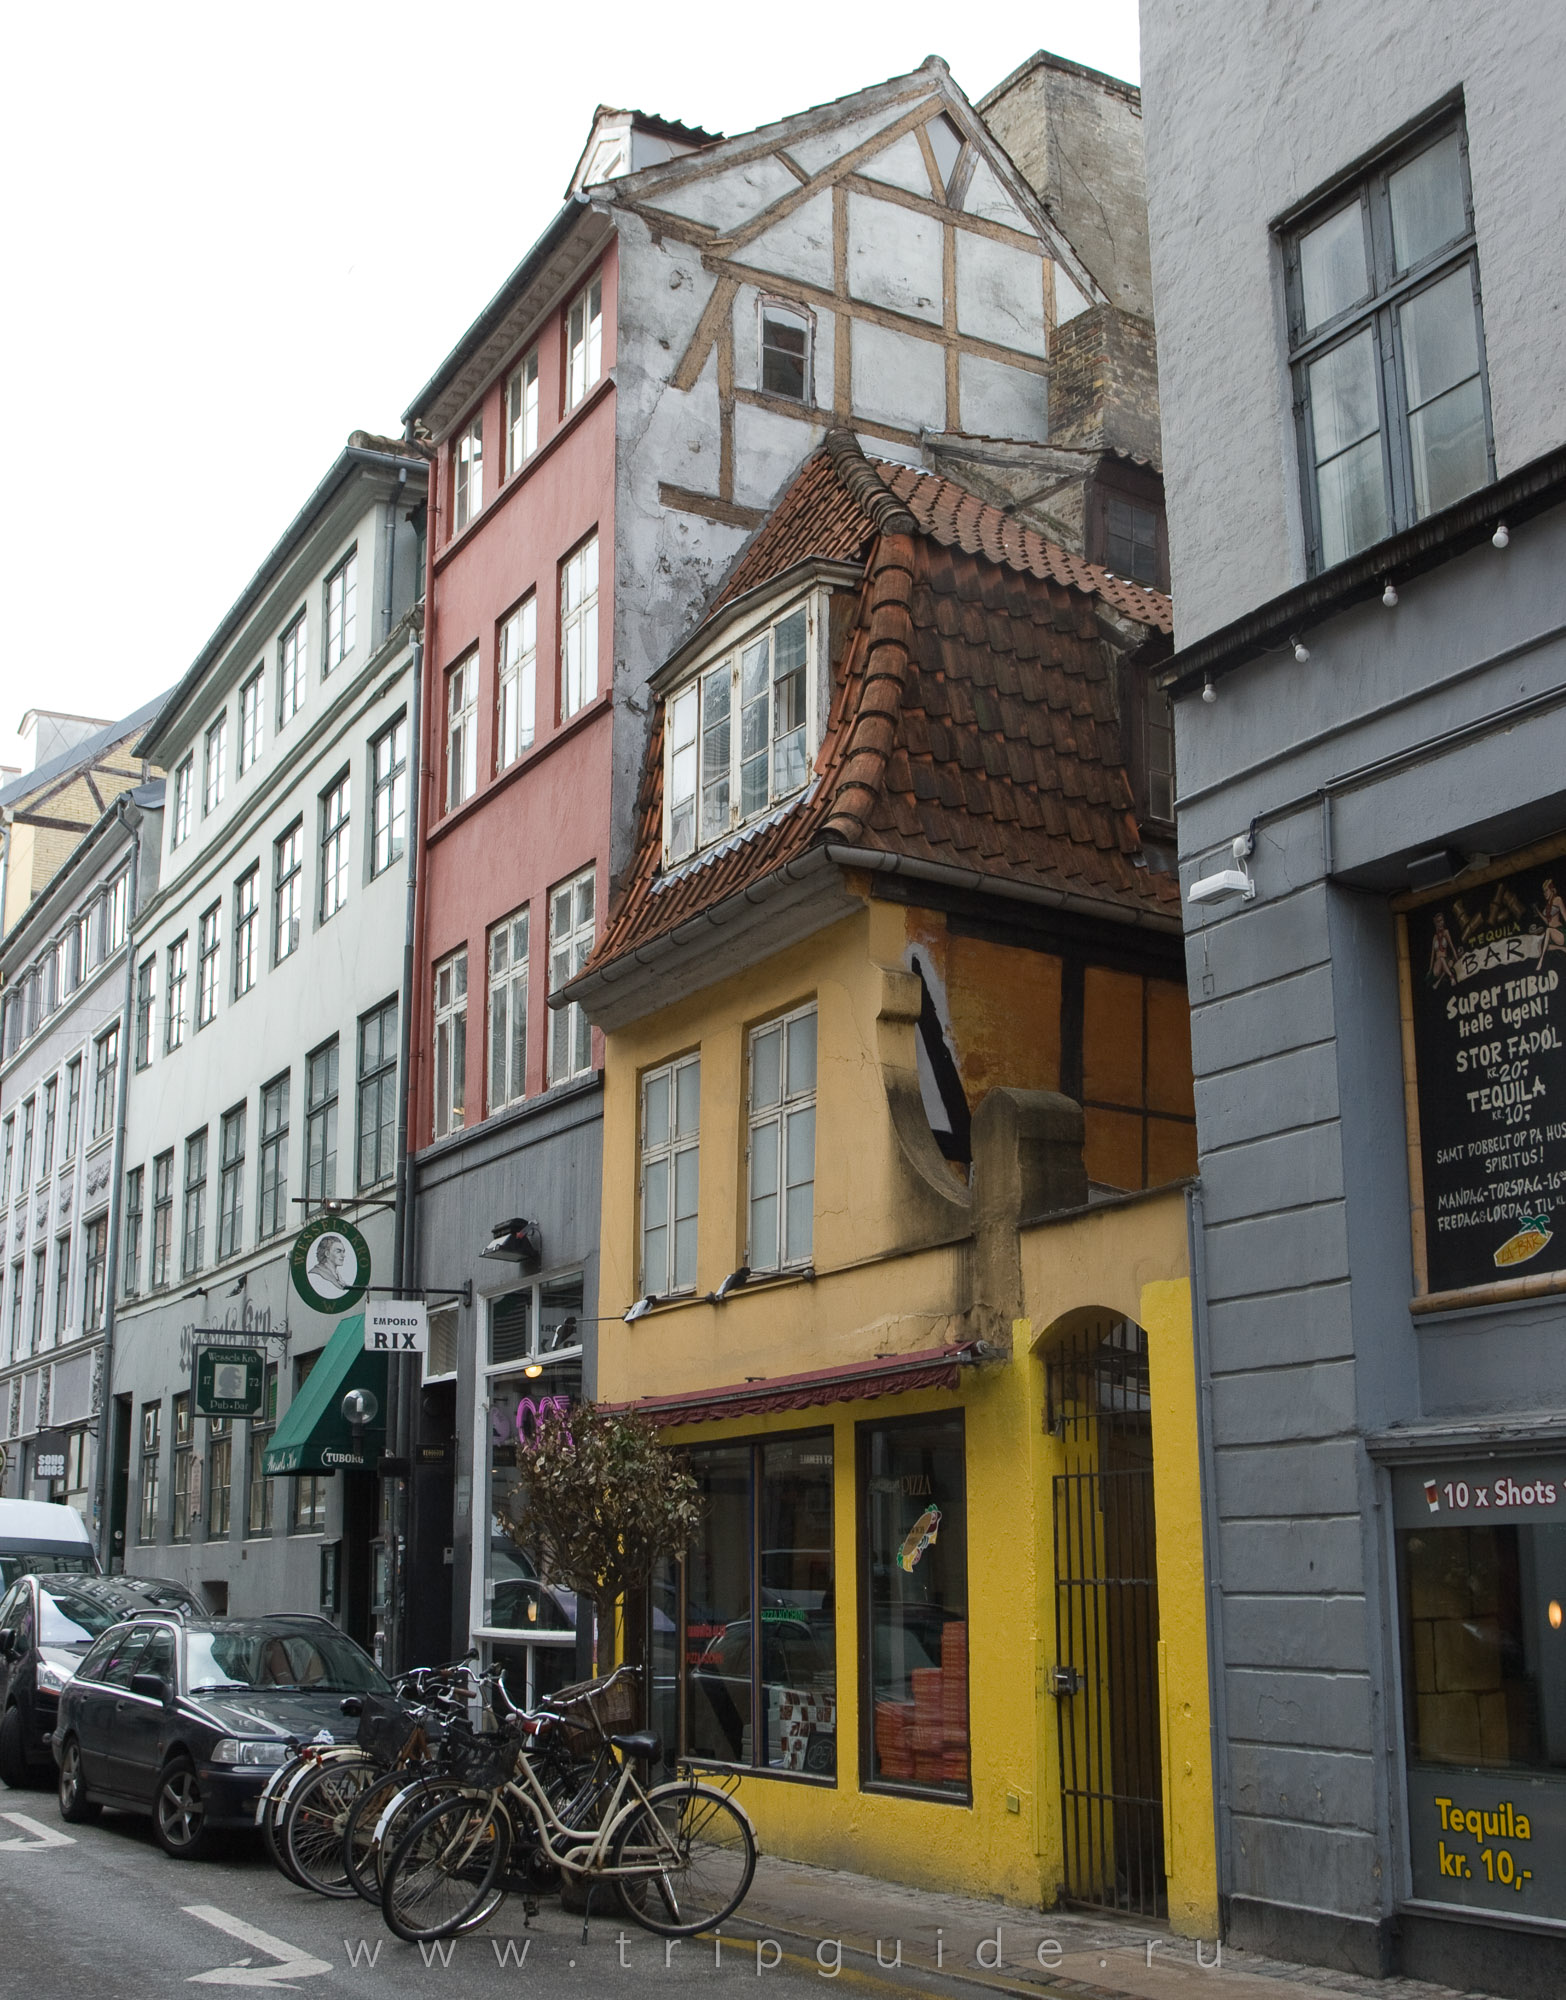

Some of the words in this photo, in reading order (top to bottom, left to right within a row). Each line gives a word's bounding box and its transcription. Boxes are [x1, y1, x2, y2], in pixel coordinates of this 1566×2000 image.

[1469, 922, 1521, 947] TEQUILA
[1462, 938, 1525, 975] BAR
[1456, 1041, 1502, 1072] STOR
[1507, 1024, 1562, 1059] FADØL
[1466, 1075, 1546, 1112] TEQUILA
[1436, 1145, 1464, 1164] SAMT
[1468, 1134, 1512, 1157] DOBBELT
[1513, 1130, 1527, 1147] OP
[1535, 1198, 1555, 1213] TIL
[294, 1219, 350, 1266] WESSELS
[373, 1317, 418, 1326] EMPORIO
[374, 1331, 416, 1349] RIX
[207, 1352, 240, 1362] Wessels
[242, 1353, 257, 1363] Kro
[203, 1375, 212, 1385] 17
[249, 1377, 259, 1387] 72
[210, 1400, 229, 1409] Pub
[234, 1401, 249, 1410] Bar
[38, 1454, 65, 1465] SOHO
[1443, 1482, 1469, 1508] 10
[1475, 1488, 1490, 1507] x
[1494, 1478, 1556, 1506] Shots
[1435, 1797, 1531, 1843] Tequila
[1438, 1840, 1472, 1879] kr.
[1481, 1848, 1532, 1890] 10,-
